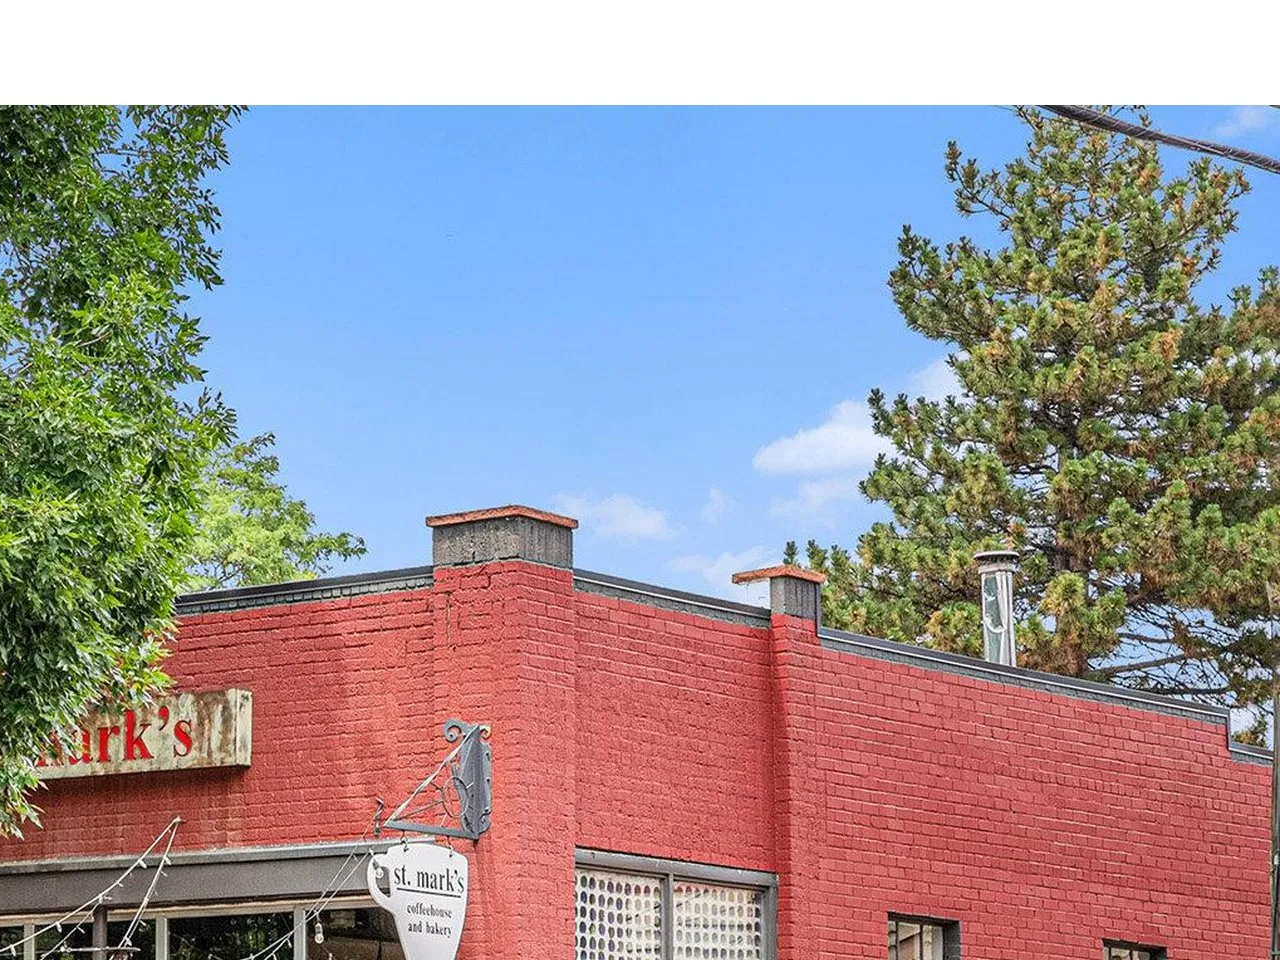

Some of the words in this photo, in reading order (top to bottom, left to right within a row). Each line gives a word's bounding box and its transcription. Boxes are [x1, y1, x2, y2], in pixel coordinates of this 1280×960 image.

[393, 864, 411, 886] st.
[416, 867, 465, 894] mark's
[406, 902, 453, 919] coffeehouse
[407, 920, 423, 933] and
[425, 921, 452, 939] bakery
